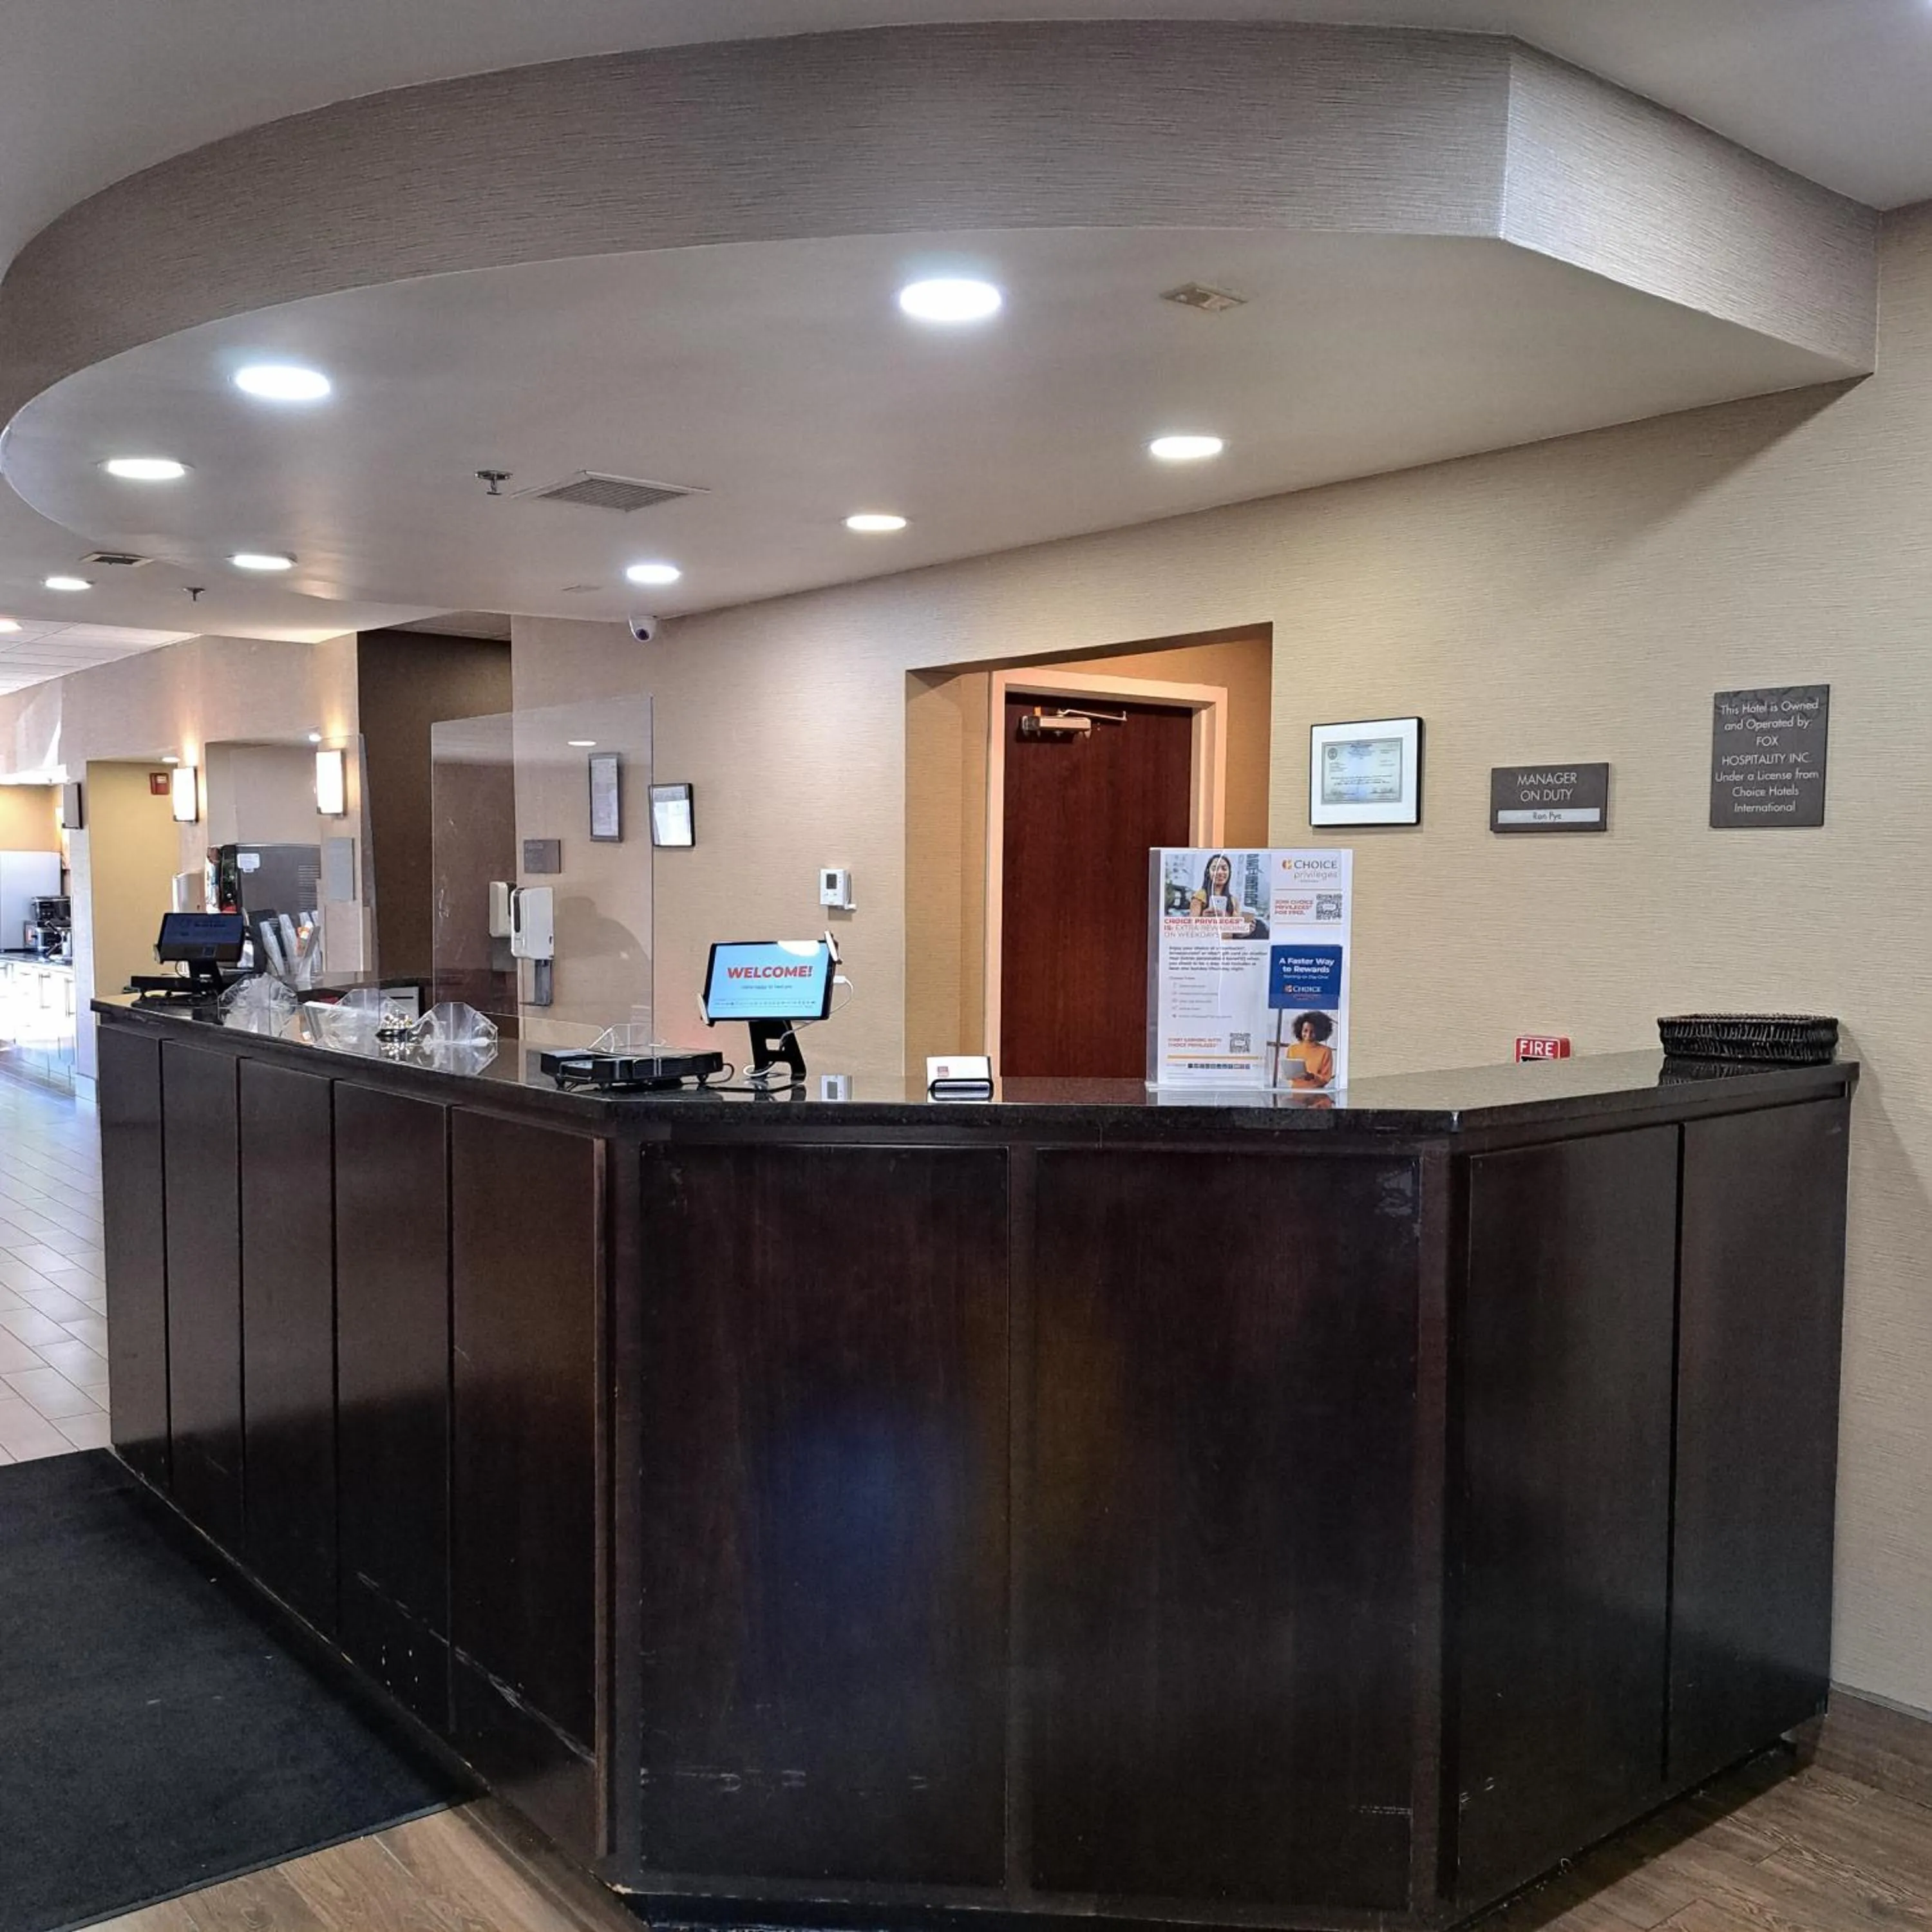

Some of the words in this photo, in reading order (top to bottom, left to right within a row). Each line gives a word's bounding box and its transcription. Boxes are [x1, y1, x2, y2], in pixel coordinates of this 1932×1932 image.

[1720, 703, 1739, 715] This
[1742, 701, 1768, 714] Hotel
[1770, 701, 1778, 712] is
[1781, 697, 1819, 712] Owned
[1724, 719, 1744, 731] and
[1746, 716, 1794, 732] Operated
[1756, 735, 1779, 747] FOX
[1721, 753, 1786, 766] HOSPITALITY
[1517, 772, 1578, 787] MANAGER
[1714, 770, 1744, 782] Under
[1757, 771, 1793, 781] License
[1795, 767, 1819, 780] from
[1520, 790, 1540, 802] ON
[1543, 788, 1575, 802] DUTY
[1732, 786, 1766, 798] Choice
[1769, 784, 1800, 797] Hotels
[1734, 799, 1796, 813] International
[1294, 859, 1338, 869] CHOICE
[1316, 958, 1335, 967] Way
[727, 965, 814, 979] WELCOME!
[1520, 1040, 1555, 1056] FIRE
